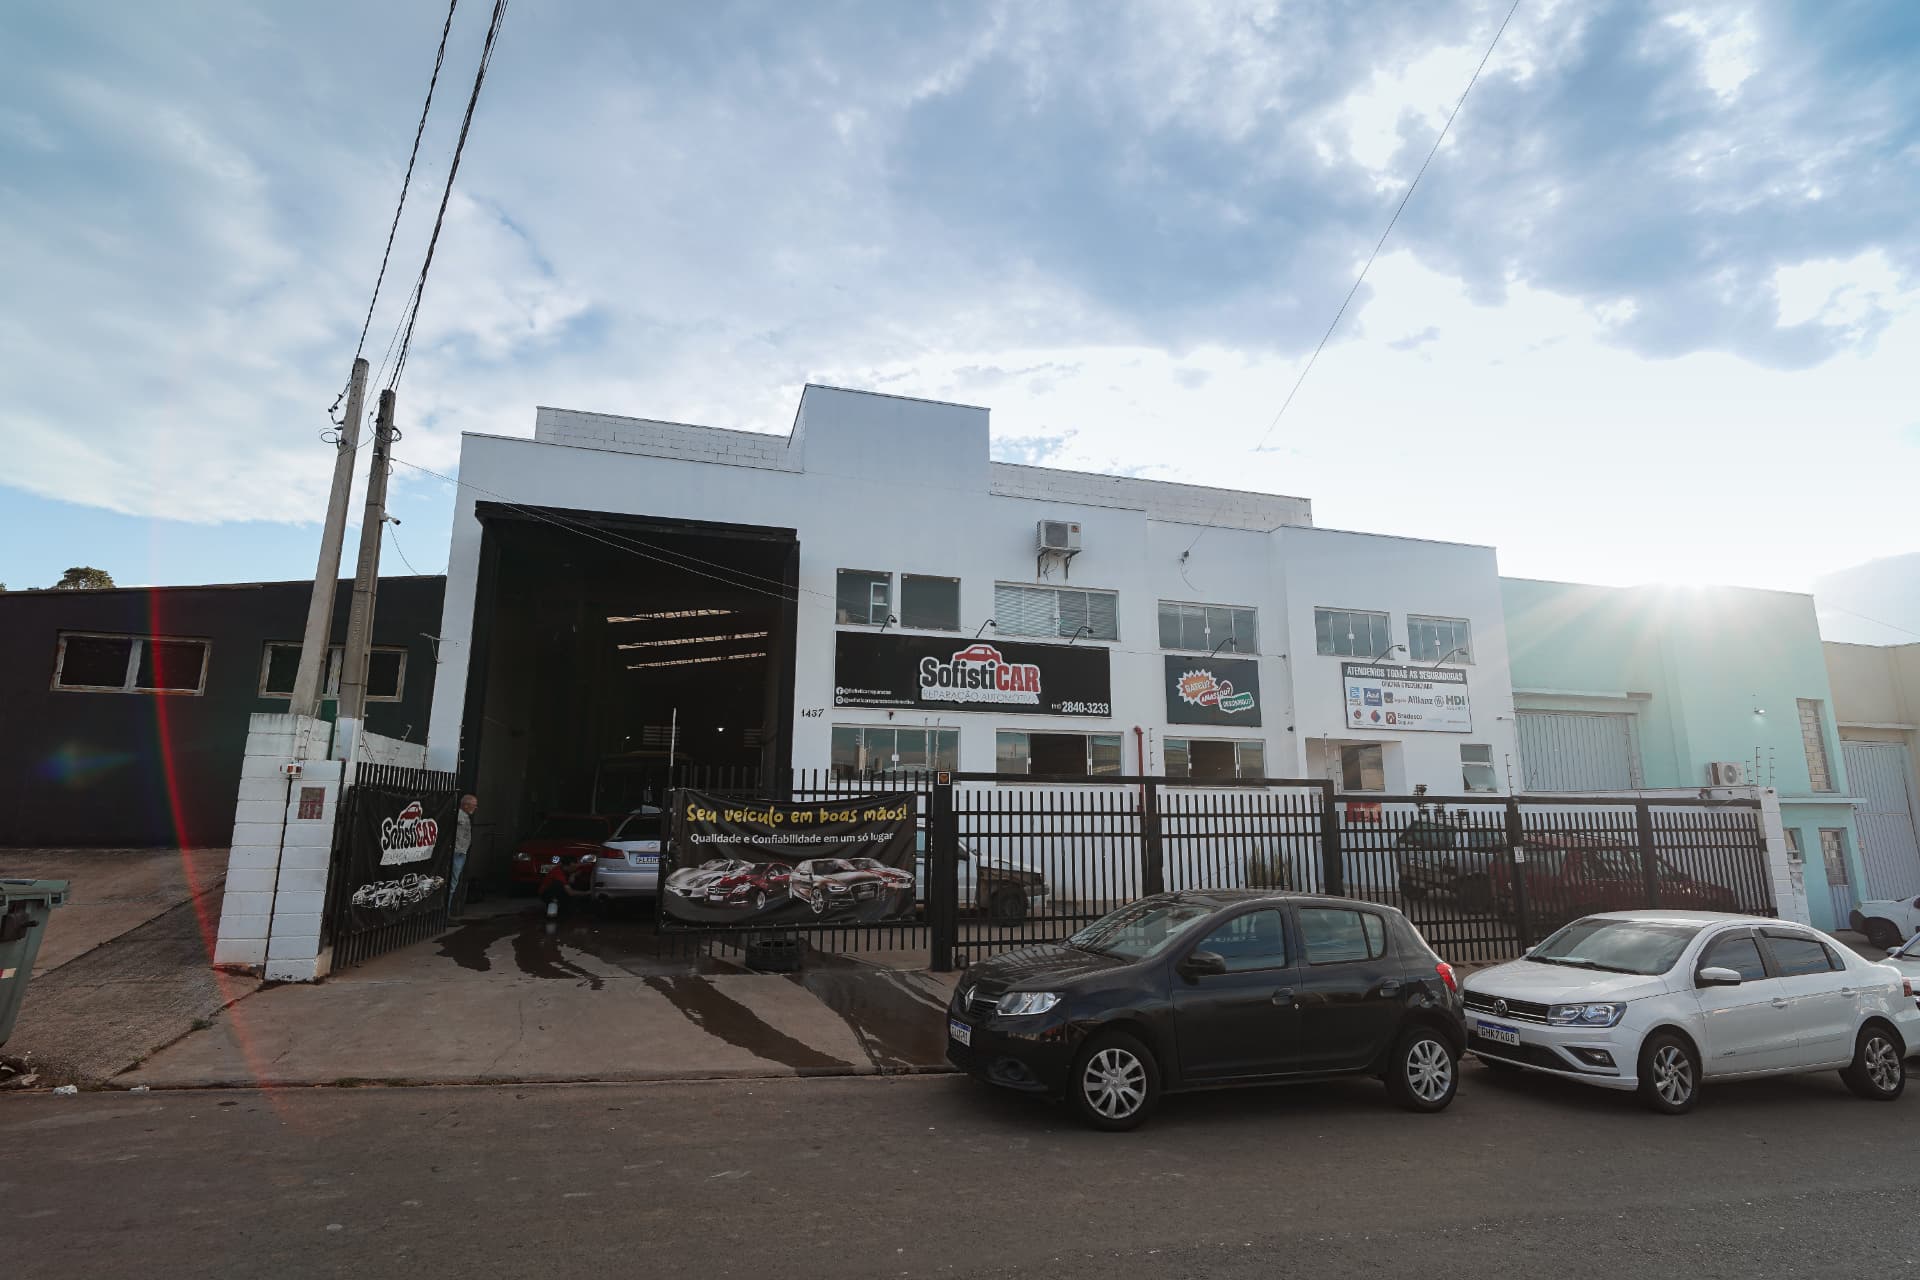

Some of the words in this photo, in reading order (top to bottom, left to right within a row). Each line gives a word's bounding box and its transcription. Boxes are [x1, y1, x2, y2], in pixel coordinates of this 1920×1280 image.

[921, 658, 1039, 693] SofistiCAR
[1408, 695, 1433, 704] Allianz
[1445, 695, 1466, 706] HDI
[1062, 700, 1109, 713] 2840-3233
[687, 803, 717, 824] Seu
[724, 805, 784, 828] veículo
[791, 811, 813, 823] em
[820, 807, 858, 823] boas
[863, 803, 907, 822] mãos!
[690, 833, 741, 845] Qualidade
[752, 834, 821, 844] Confiabilidade
[823, 835, 838, 843] em
[840, 834, 855, 843] um
[857, 832, 868, 842] só
[870, 832, 894, 843] lugar
